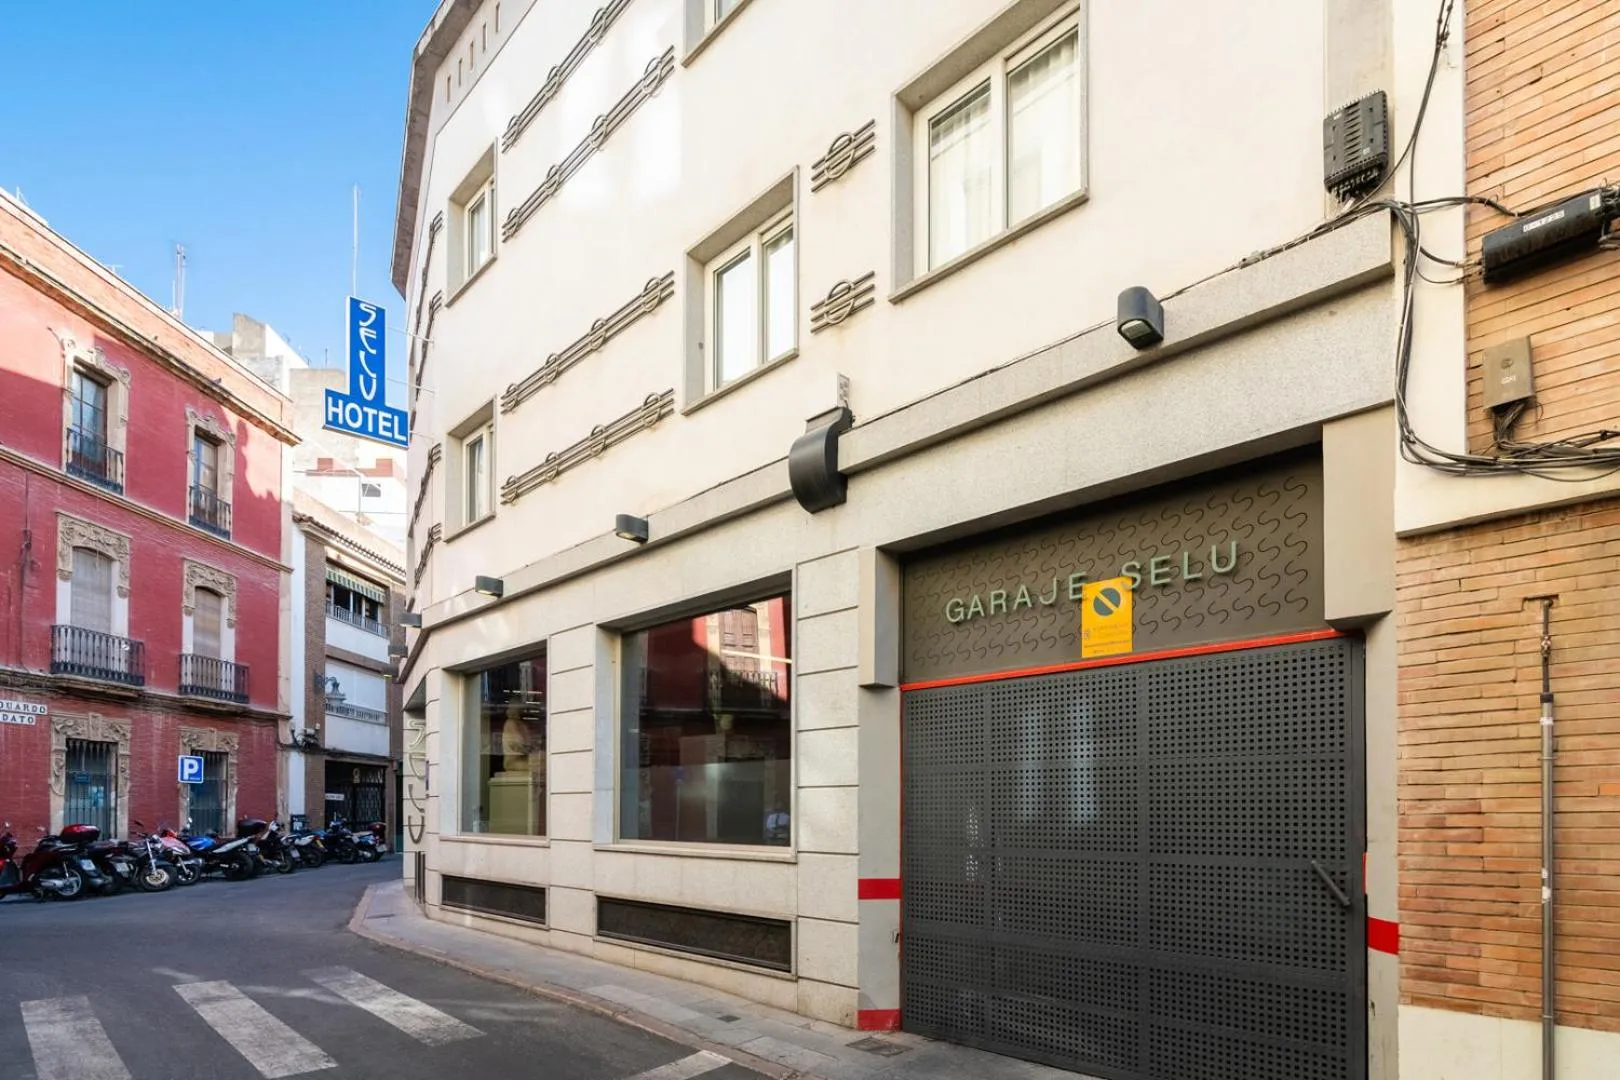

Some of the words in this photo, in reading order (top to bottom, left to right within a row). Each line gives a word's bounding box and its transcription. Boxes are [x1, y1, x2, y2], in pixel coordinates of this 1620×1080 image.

[359, 303, 377, 401] SELU
[327, 396, 407, 442] HOTEL
[945, 571, 1087, 623] GARAJE
[1121, 540, 1237, 591] SELU
[2, 713, 34, 724] DATO
[183, 758, 199, 781] P
